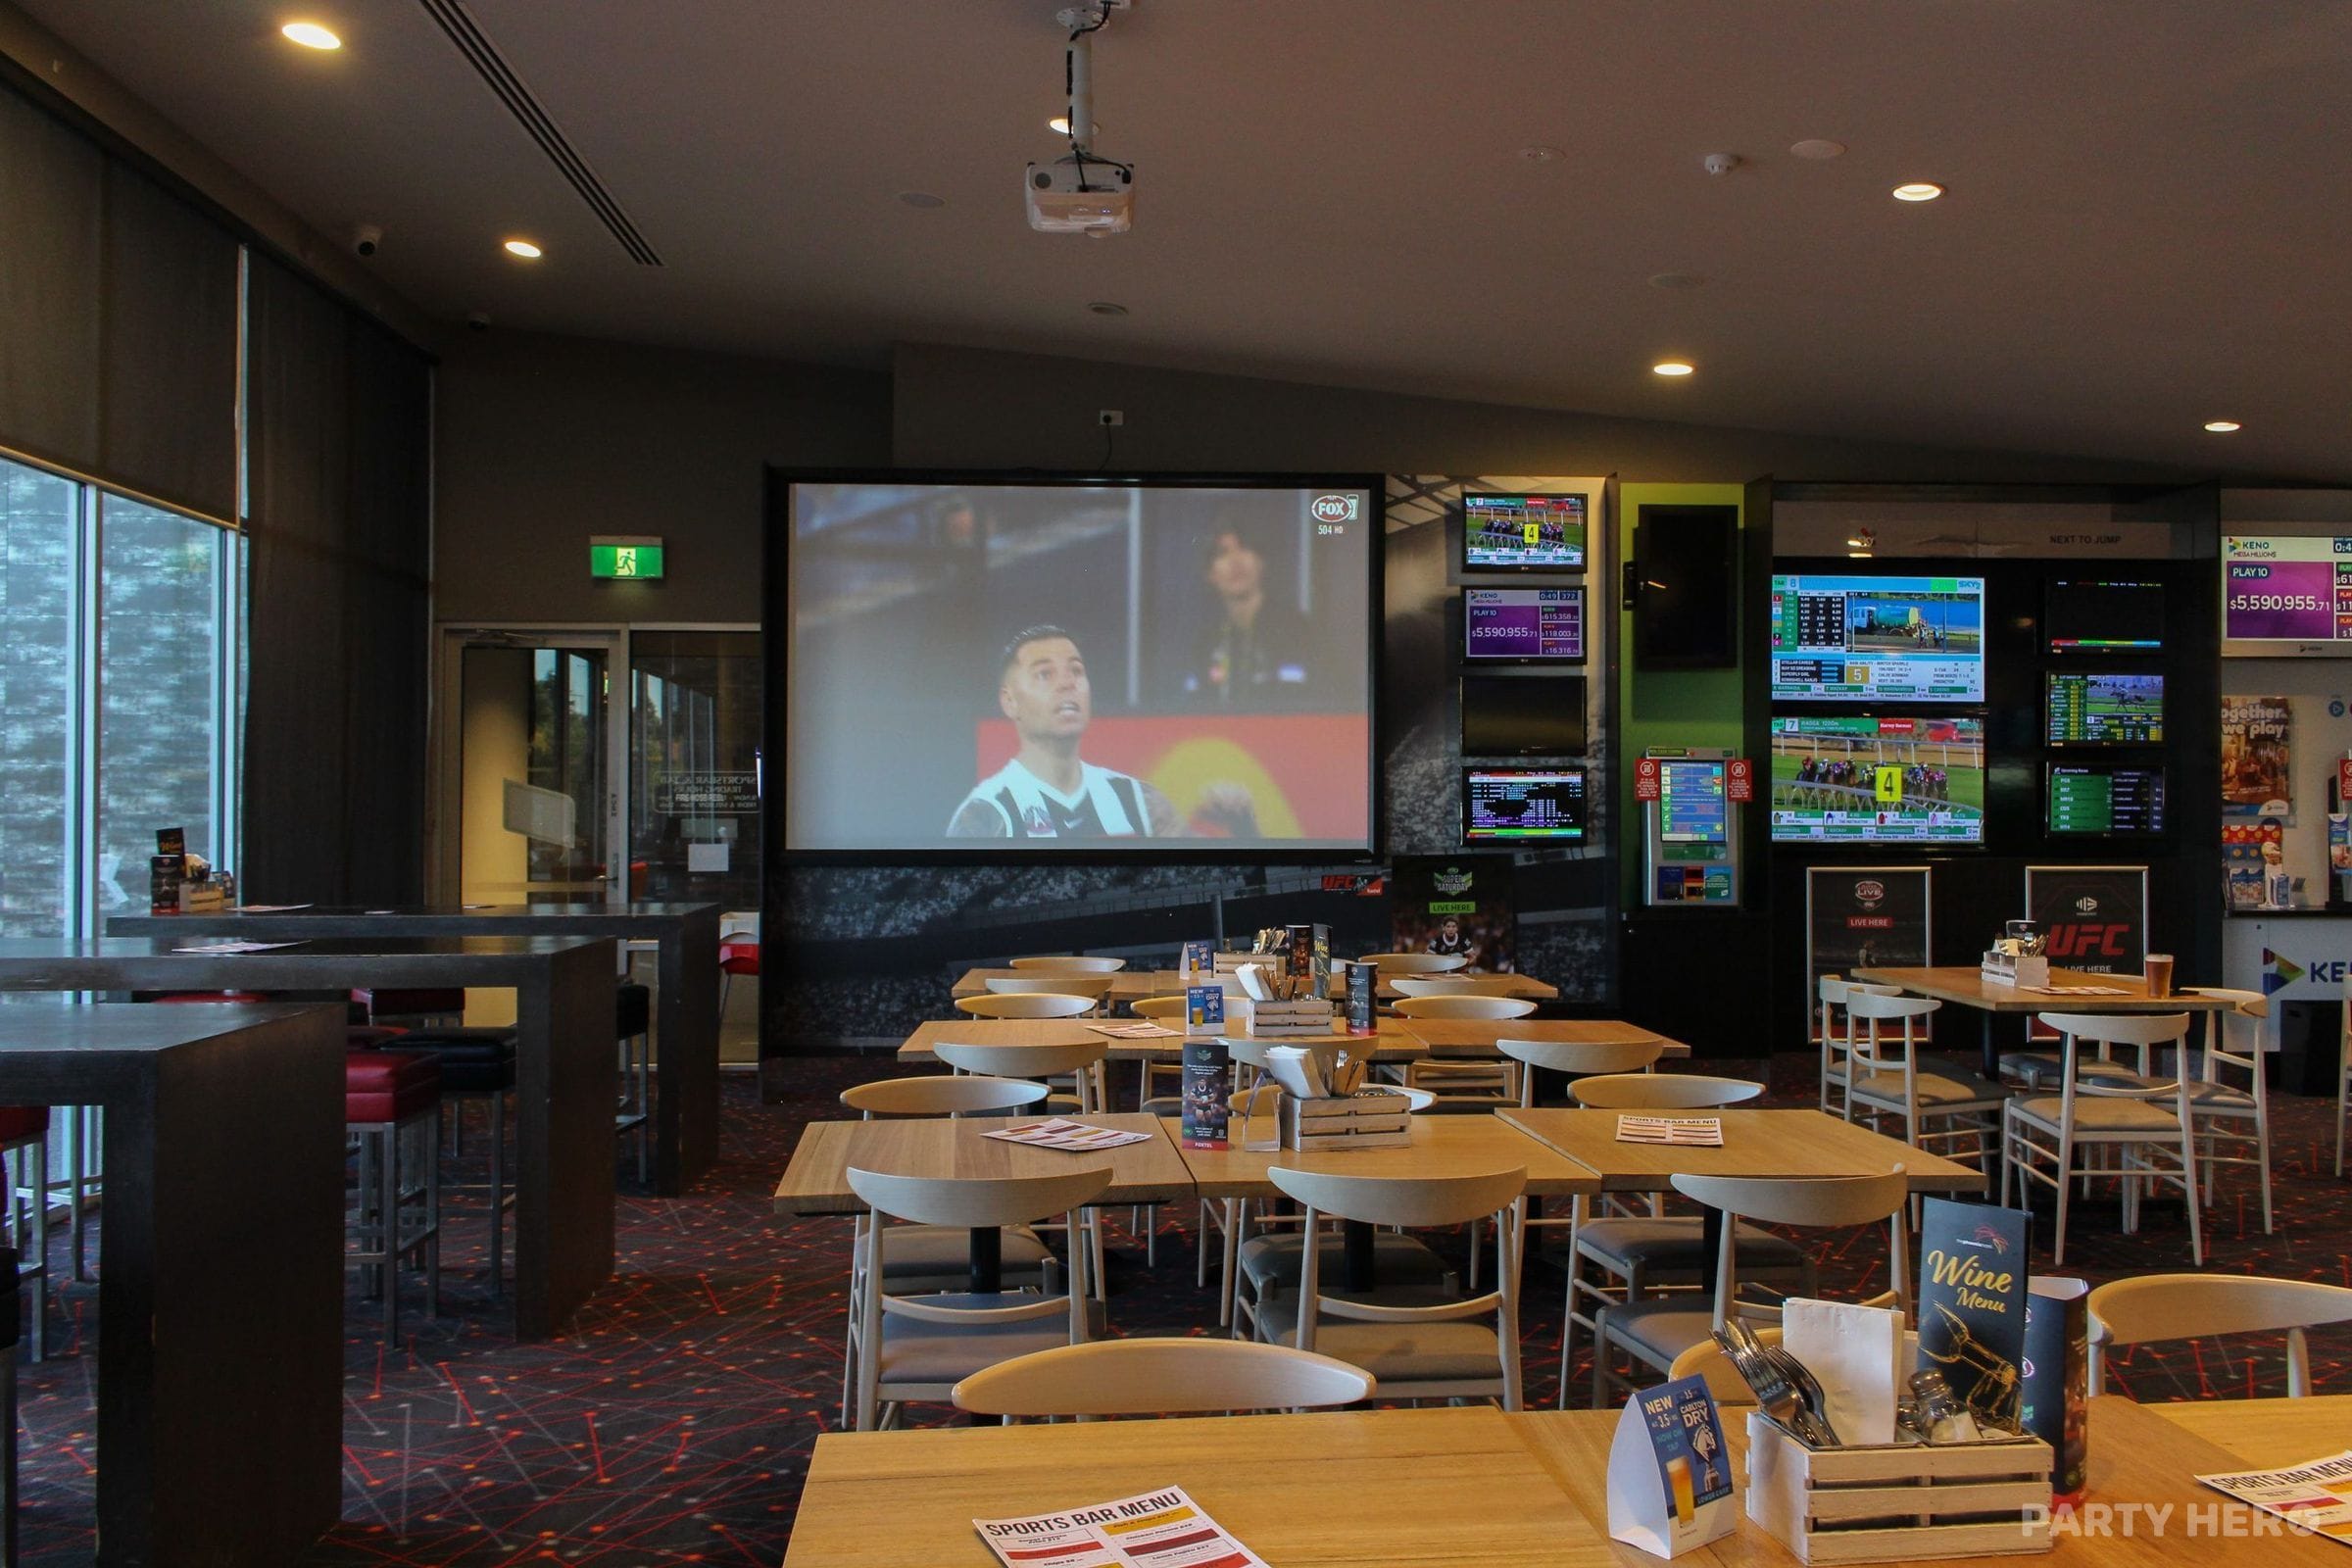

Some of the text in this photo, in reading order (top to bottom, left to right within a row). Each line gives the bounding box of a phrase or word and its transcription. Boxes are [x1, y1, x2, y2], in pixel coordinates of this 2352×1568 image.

[1318, 502, 1345, 515] FOX
[1318, 524, 1332, 535] 504
[1529, 527, 1534, 541] 4
[2049, 535, 2122, 544] NEXT TO JUMP
[2242, 541, 2269, 550] KENO
[2232, 567, 2256, 577] PLAY
[2257, 567, 2268, 577] 10
[2230, 595, 2329, 612] $5,590,955.71
[1853, 668, 1862, 681] 5
[2222, 704, 2281, 723] ogether
[2223, 720, 2285, 741] we play
[1884, 771, 1893, 798] 4
[1323, 875, 1355, 888] UFC
[1443, 874, 1463, 883] SUPER
[1857, 887, 1881, 896] LIVE
[2044, 924, 2131, 956] UFC
[2310, 961, 2352, 983] KE
[1928, 1250, 2012, 1294] Wine
[1956, 1287, 2007, 1313] Menu
[1644, 1395, 1673, 1415] NEW
[1679, 1398, 1707, 1415] CARLTON
[1683, 1407, 1710, 1428] DRY
[2211, 1474, 2285, 1490] SPORTS
[2275, 1470, 2324, 1485] BAR
[985, 1493, 1182, 1538] SPORTS BAR MENU
